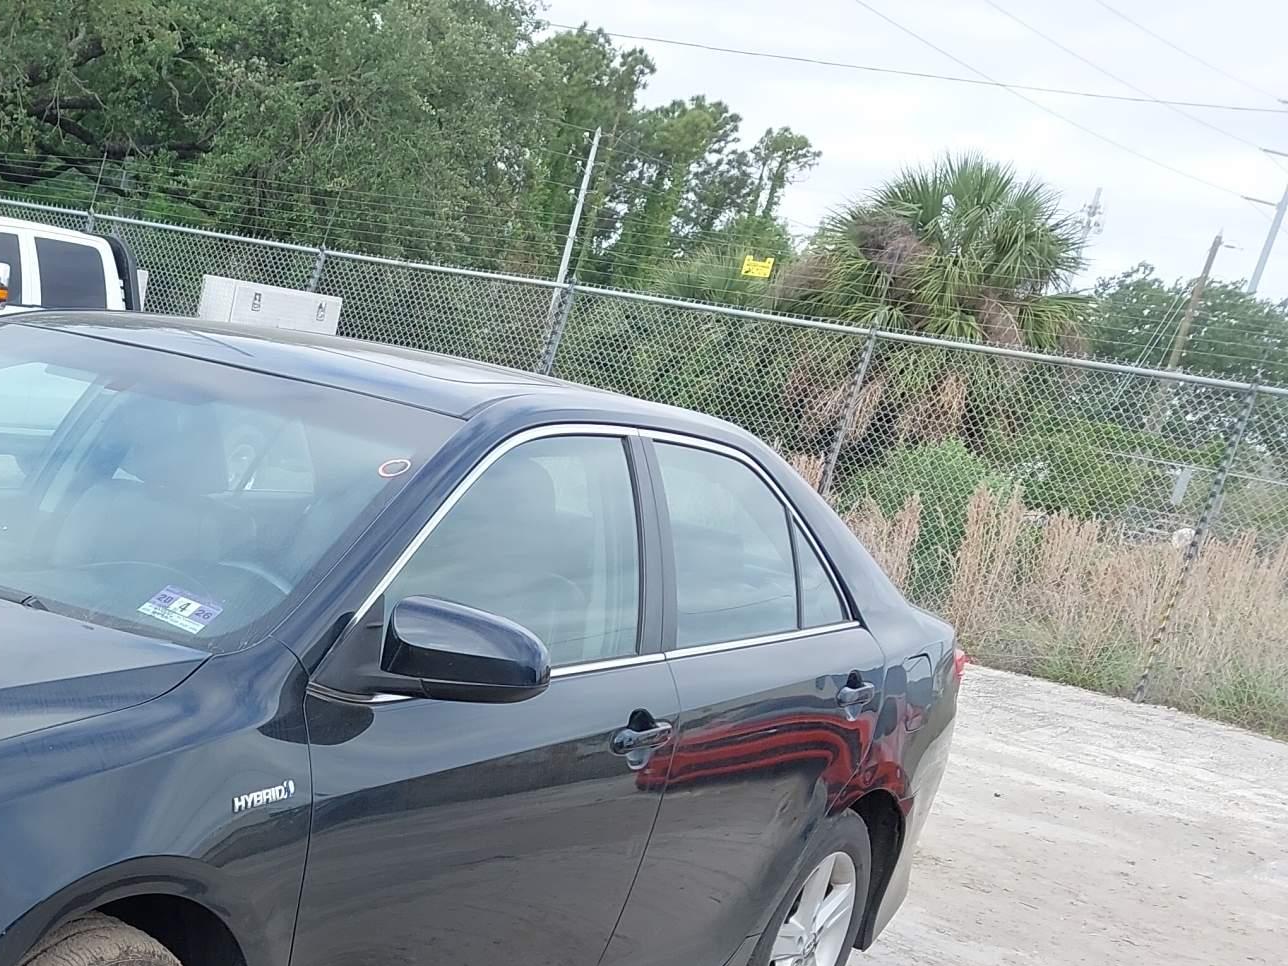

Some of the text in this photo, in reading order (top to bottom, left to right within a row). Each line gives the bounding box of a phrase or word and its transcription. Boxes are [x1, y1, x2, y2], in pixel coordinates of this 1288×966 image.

[178, 602, 192, 612] 4
[195, 609, 213, 620] 26
[233, 785, 286, 813] HYBRID
